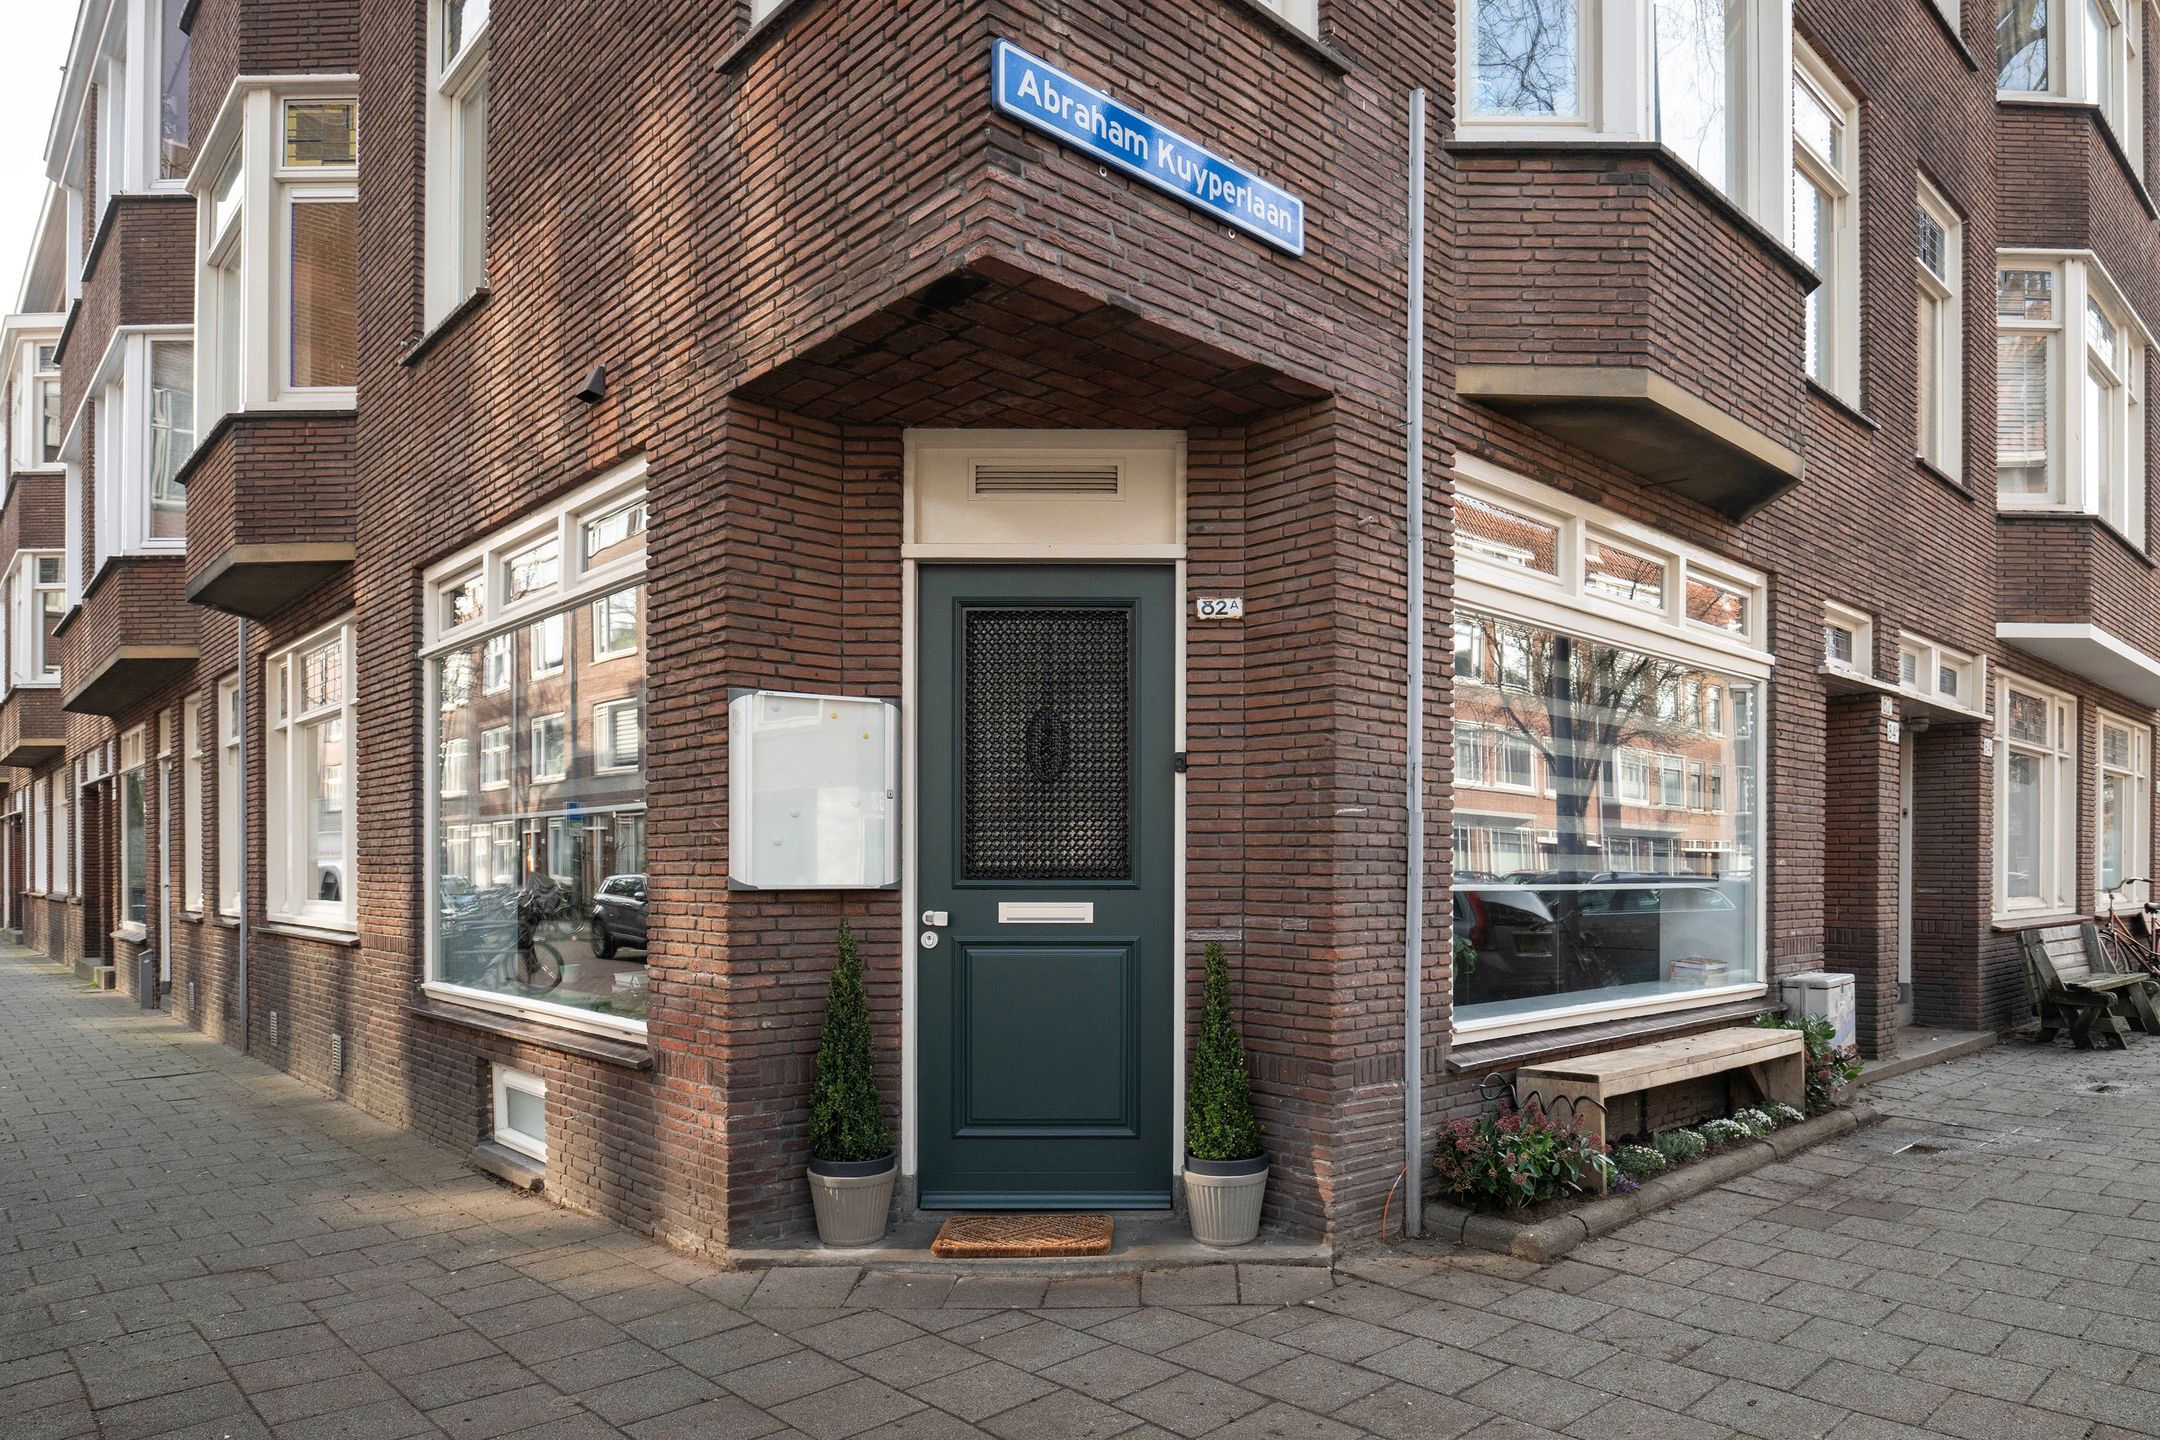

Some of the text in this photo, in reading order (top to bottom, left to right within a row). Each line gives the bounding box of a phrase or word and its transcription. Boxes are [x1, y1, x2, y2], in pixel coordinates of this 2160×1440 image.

[1017, 69, 1292, 234] Abraham Kuyperlaan
[1201, 600, 1239, 616] 82A
